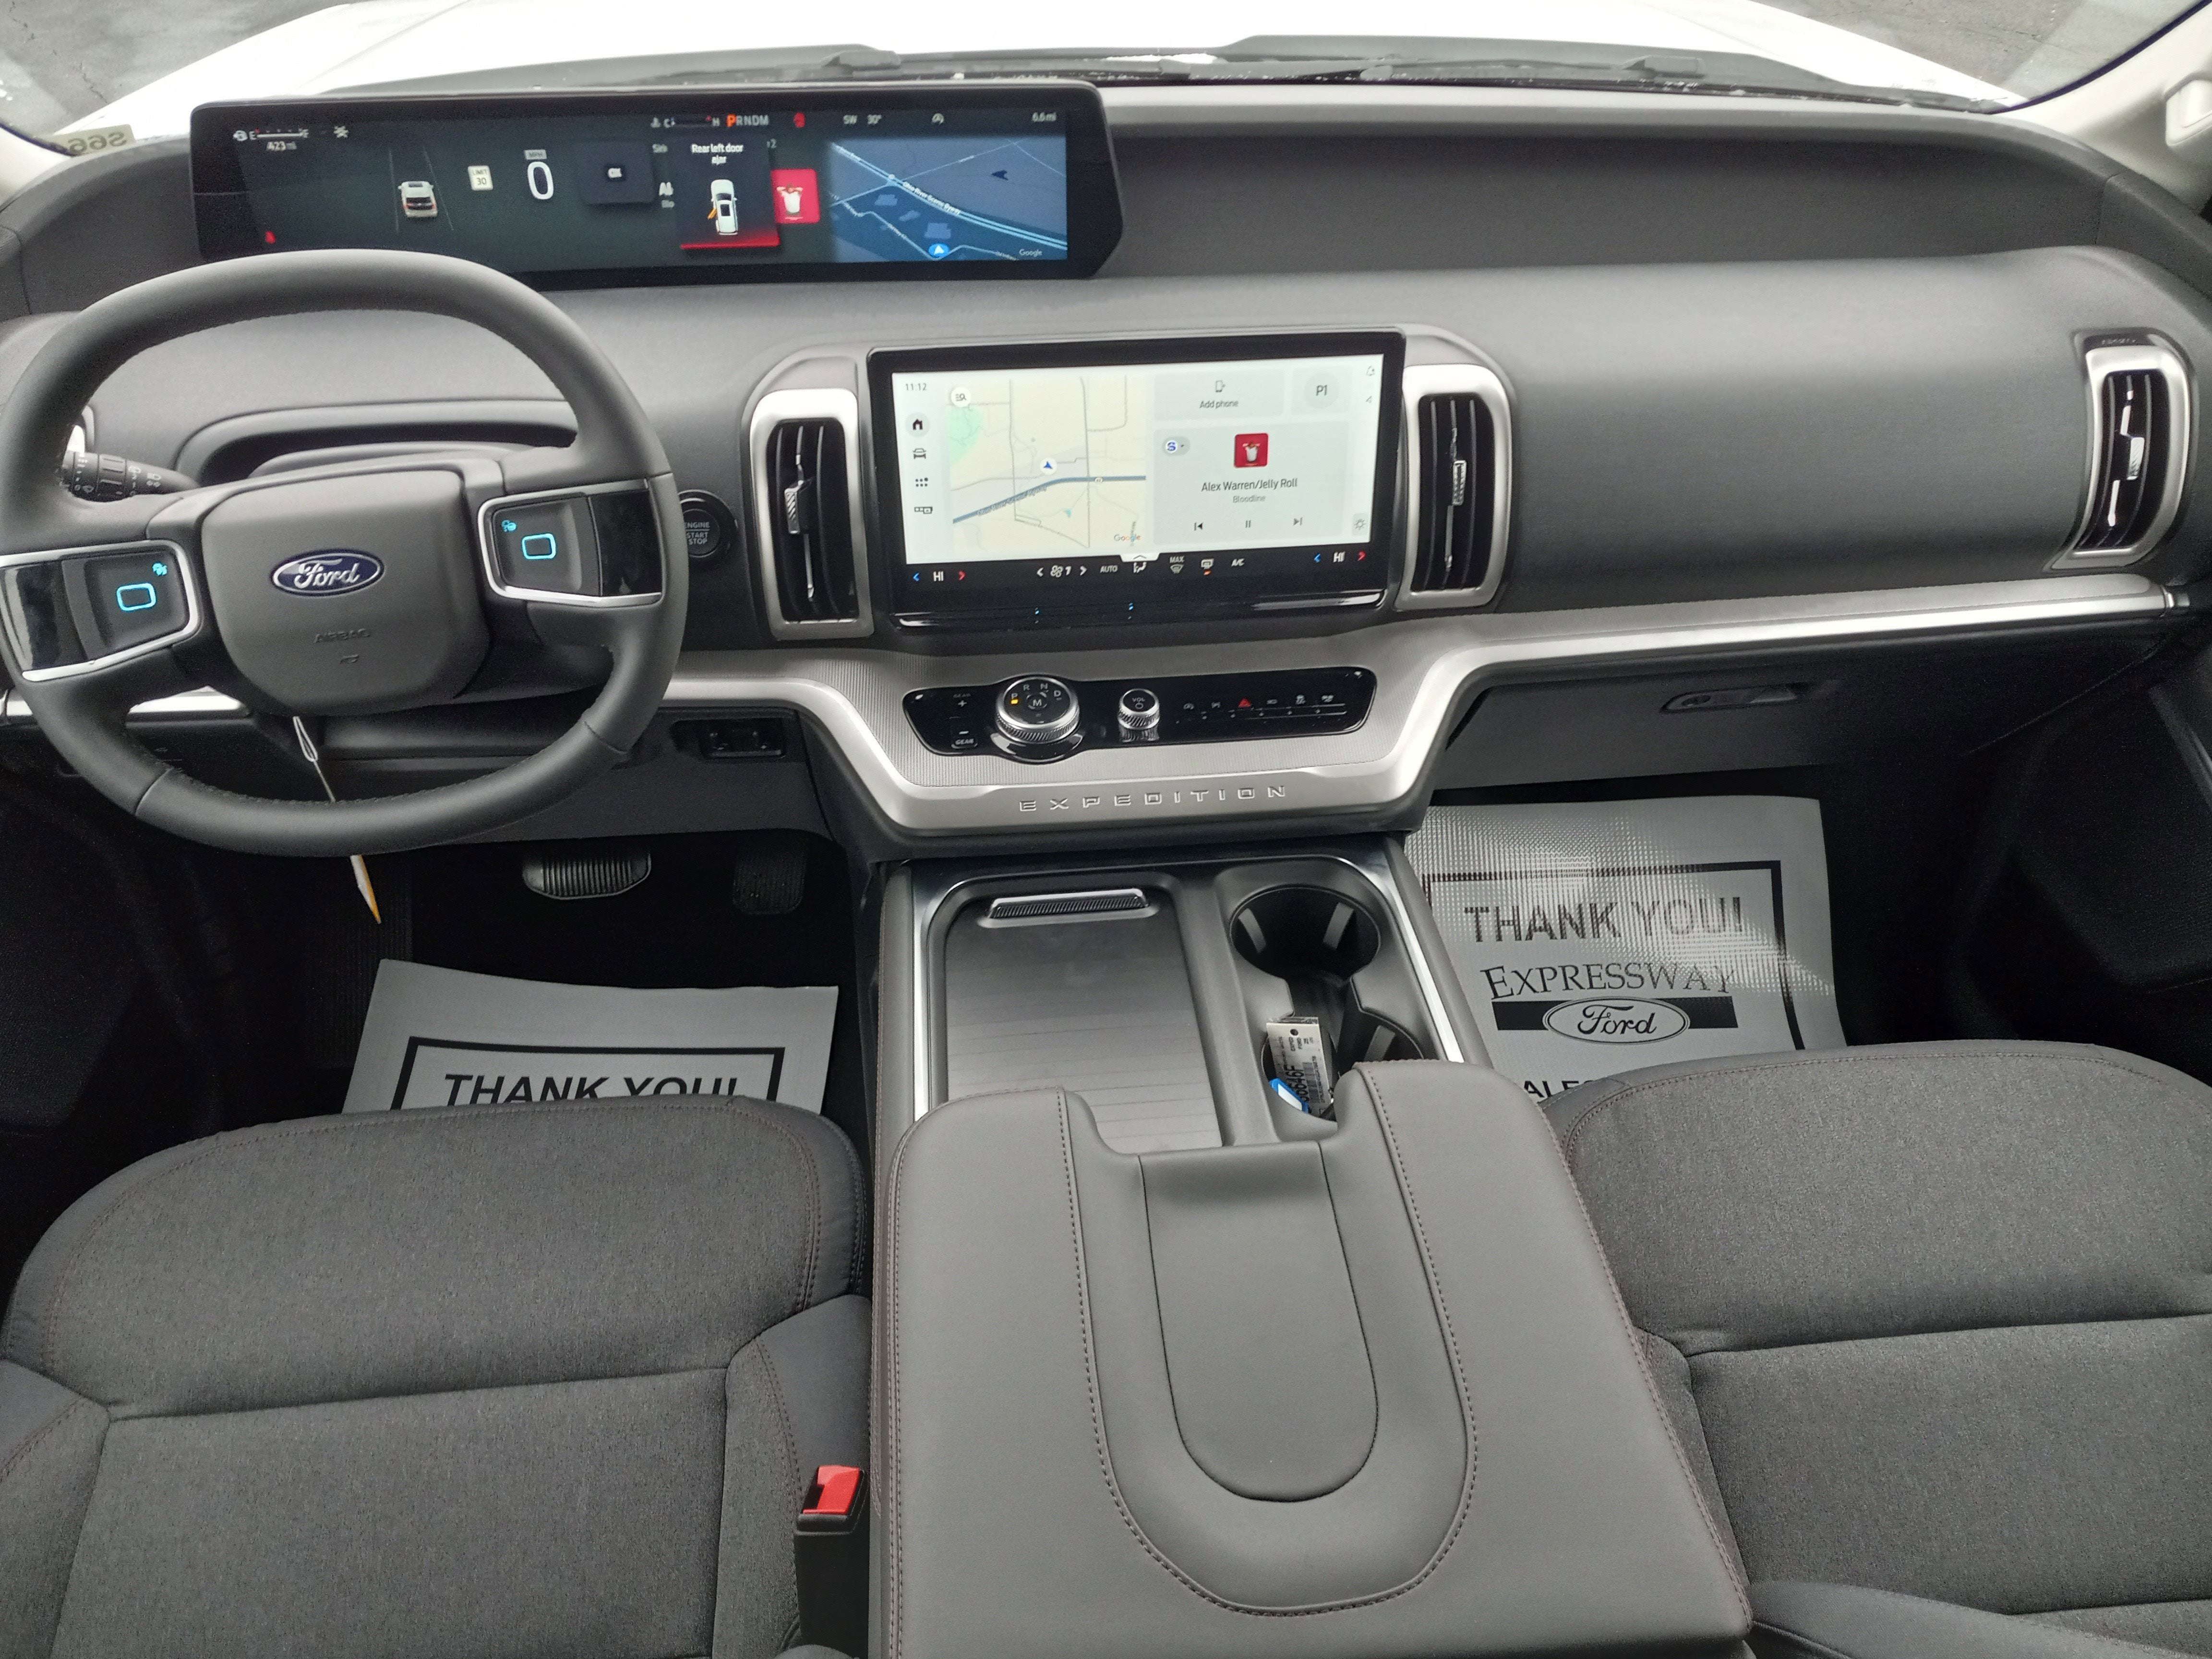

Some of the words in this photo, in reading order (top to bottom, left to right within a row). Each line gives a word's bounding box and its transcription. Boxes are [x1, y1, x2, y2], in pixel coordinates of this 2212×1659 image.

[691, 144, 709, 153] Rear
[710, 144, 725, 153] left
[725, 143, 744, 153] door
[711, 156, 727, 165] ajar
[528, 161, 553, 199] 0
[1019, 249, 1043, 257] Google
[1316, 385, 1328, 396] P1
[1200, 400, 1215, 409] Add
[1215, 400, 1239, 409] phone
[1202, 482, 1221, 492] Alex
[1223, 479, 1279, 491] Warren/Jelly
[1280, 478, 1298, 488] Roll
[1233, 494, 1266, 504] Bloodline
[1114, 534, 1141, 542] Google
[1333, 551, 1346, 563] HI
[294, 558, 360, 589] Ford
[1100, 565, 1118, 573] AUTO
[933, 571, 944, 581] HI
[1019, 785, 1286, 812] EXPEDITION
[1464, 902, 1622, 943] THANK
[1631, 896, 1743, 936] YOU!
[1577, 1004, 1657, 1035] Ford
[445, 1074, 610, 1106] THANK
